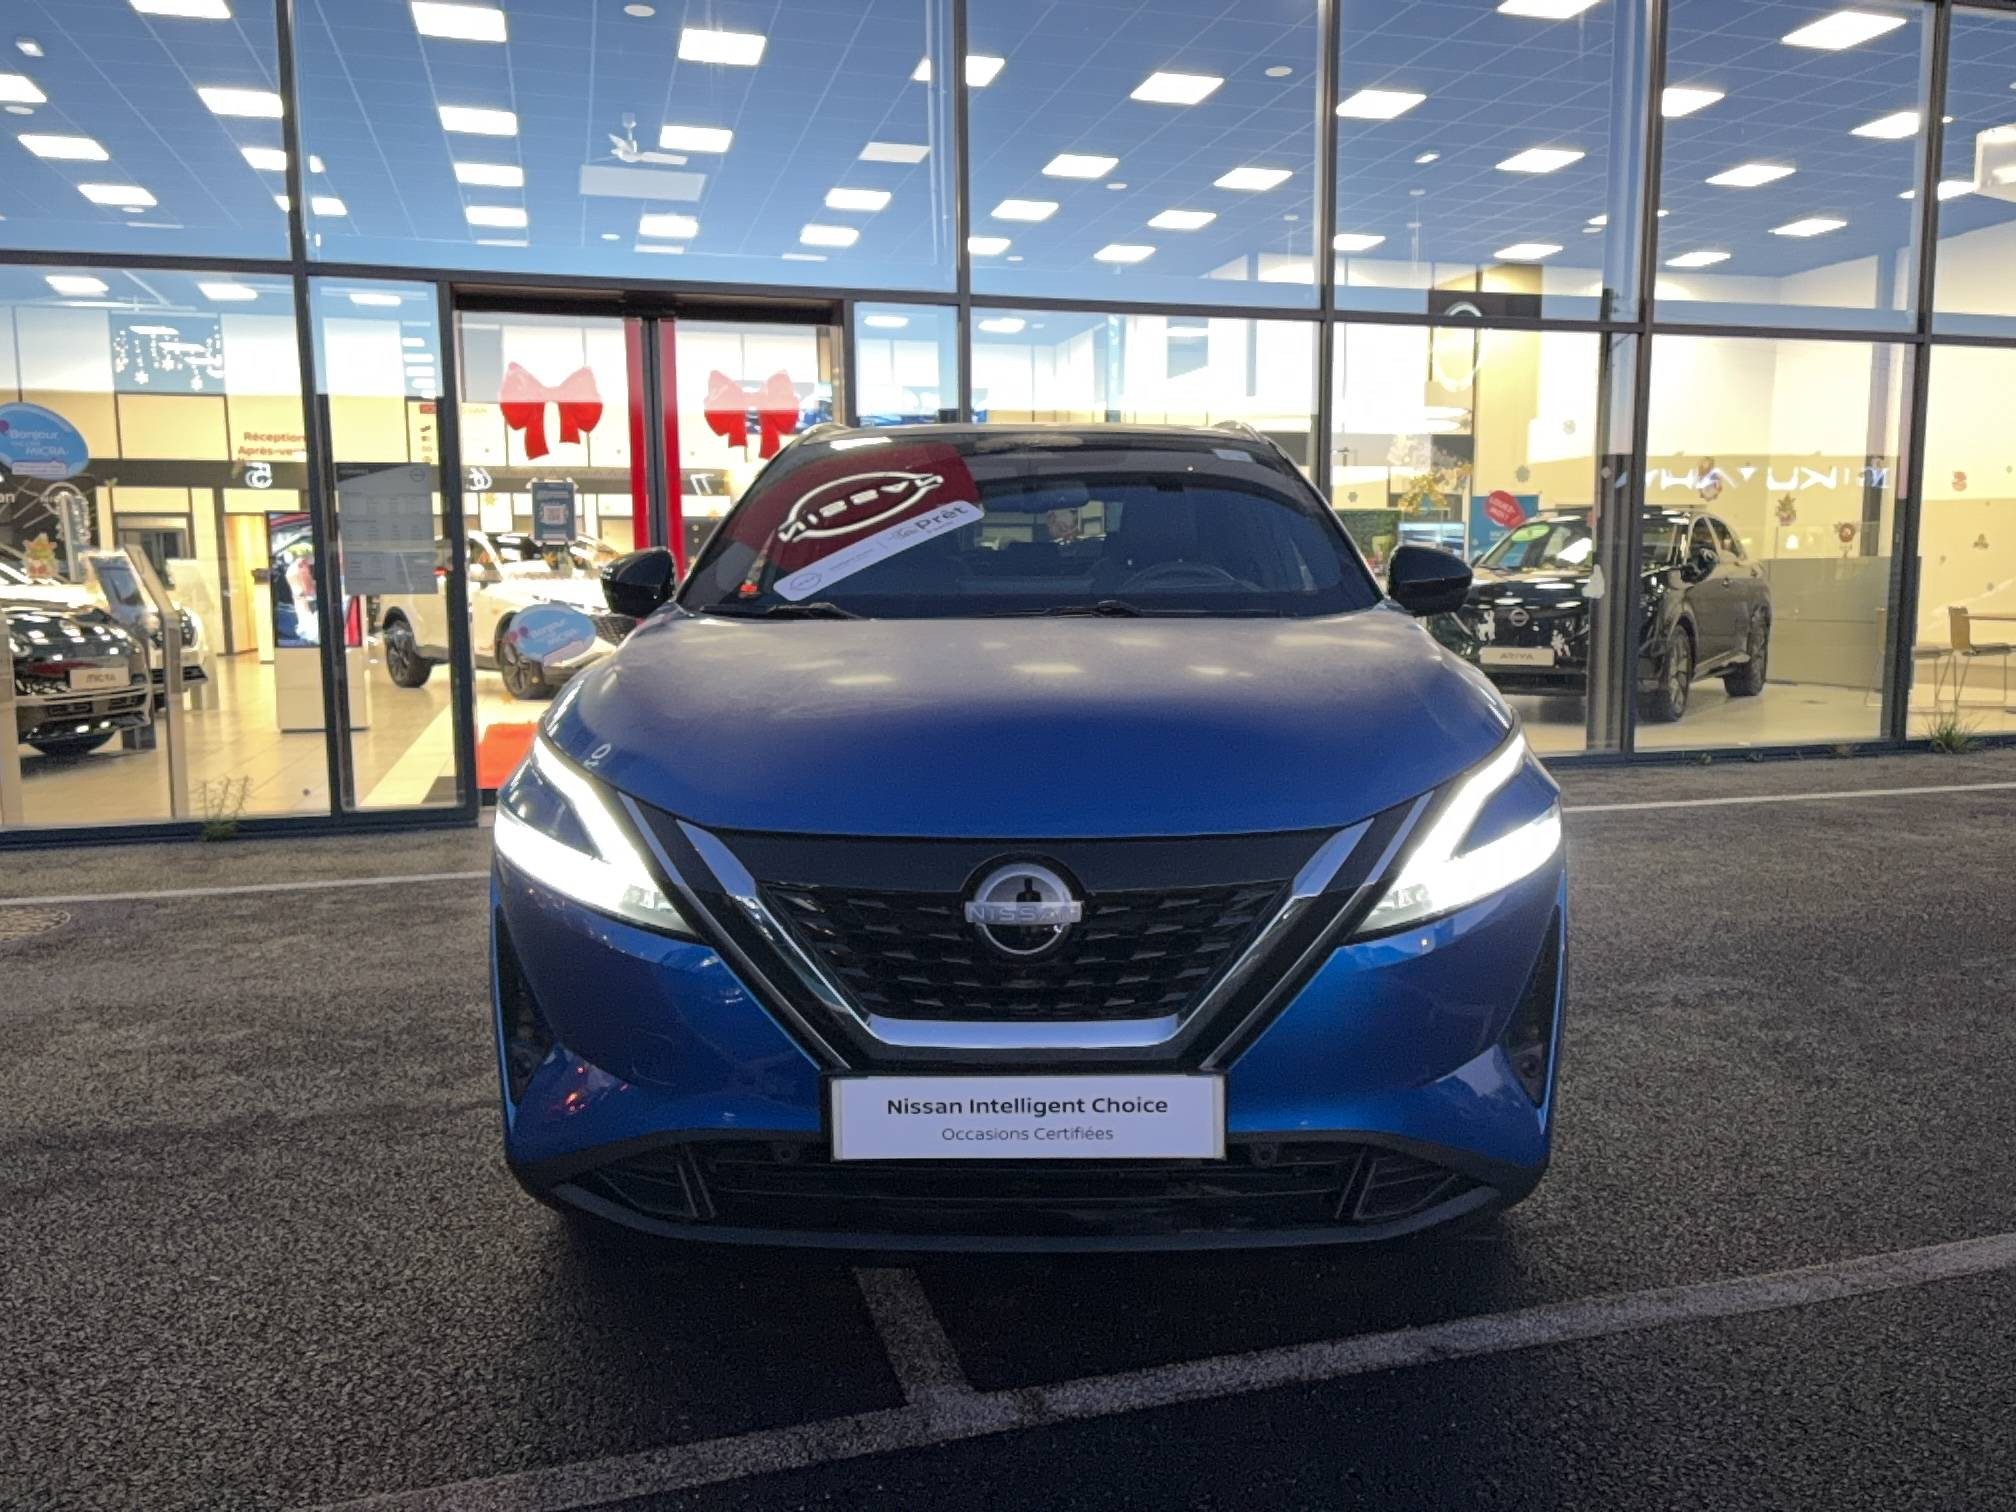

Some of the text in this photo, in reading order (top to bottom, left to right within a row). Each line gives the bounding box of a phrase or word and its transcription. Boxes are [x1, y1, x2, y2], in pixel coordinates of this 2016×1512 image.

[887, 1096, 1168, 1118] Nissan Intelligent Choice
[941, 1126, 1114, 1141] Occasions Certifiées
